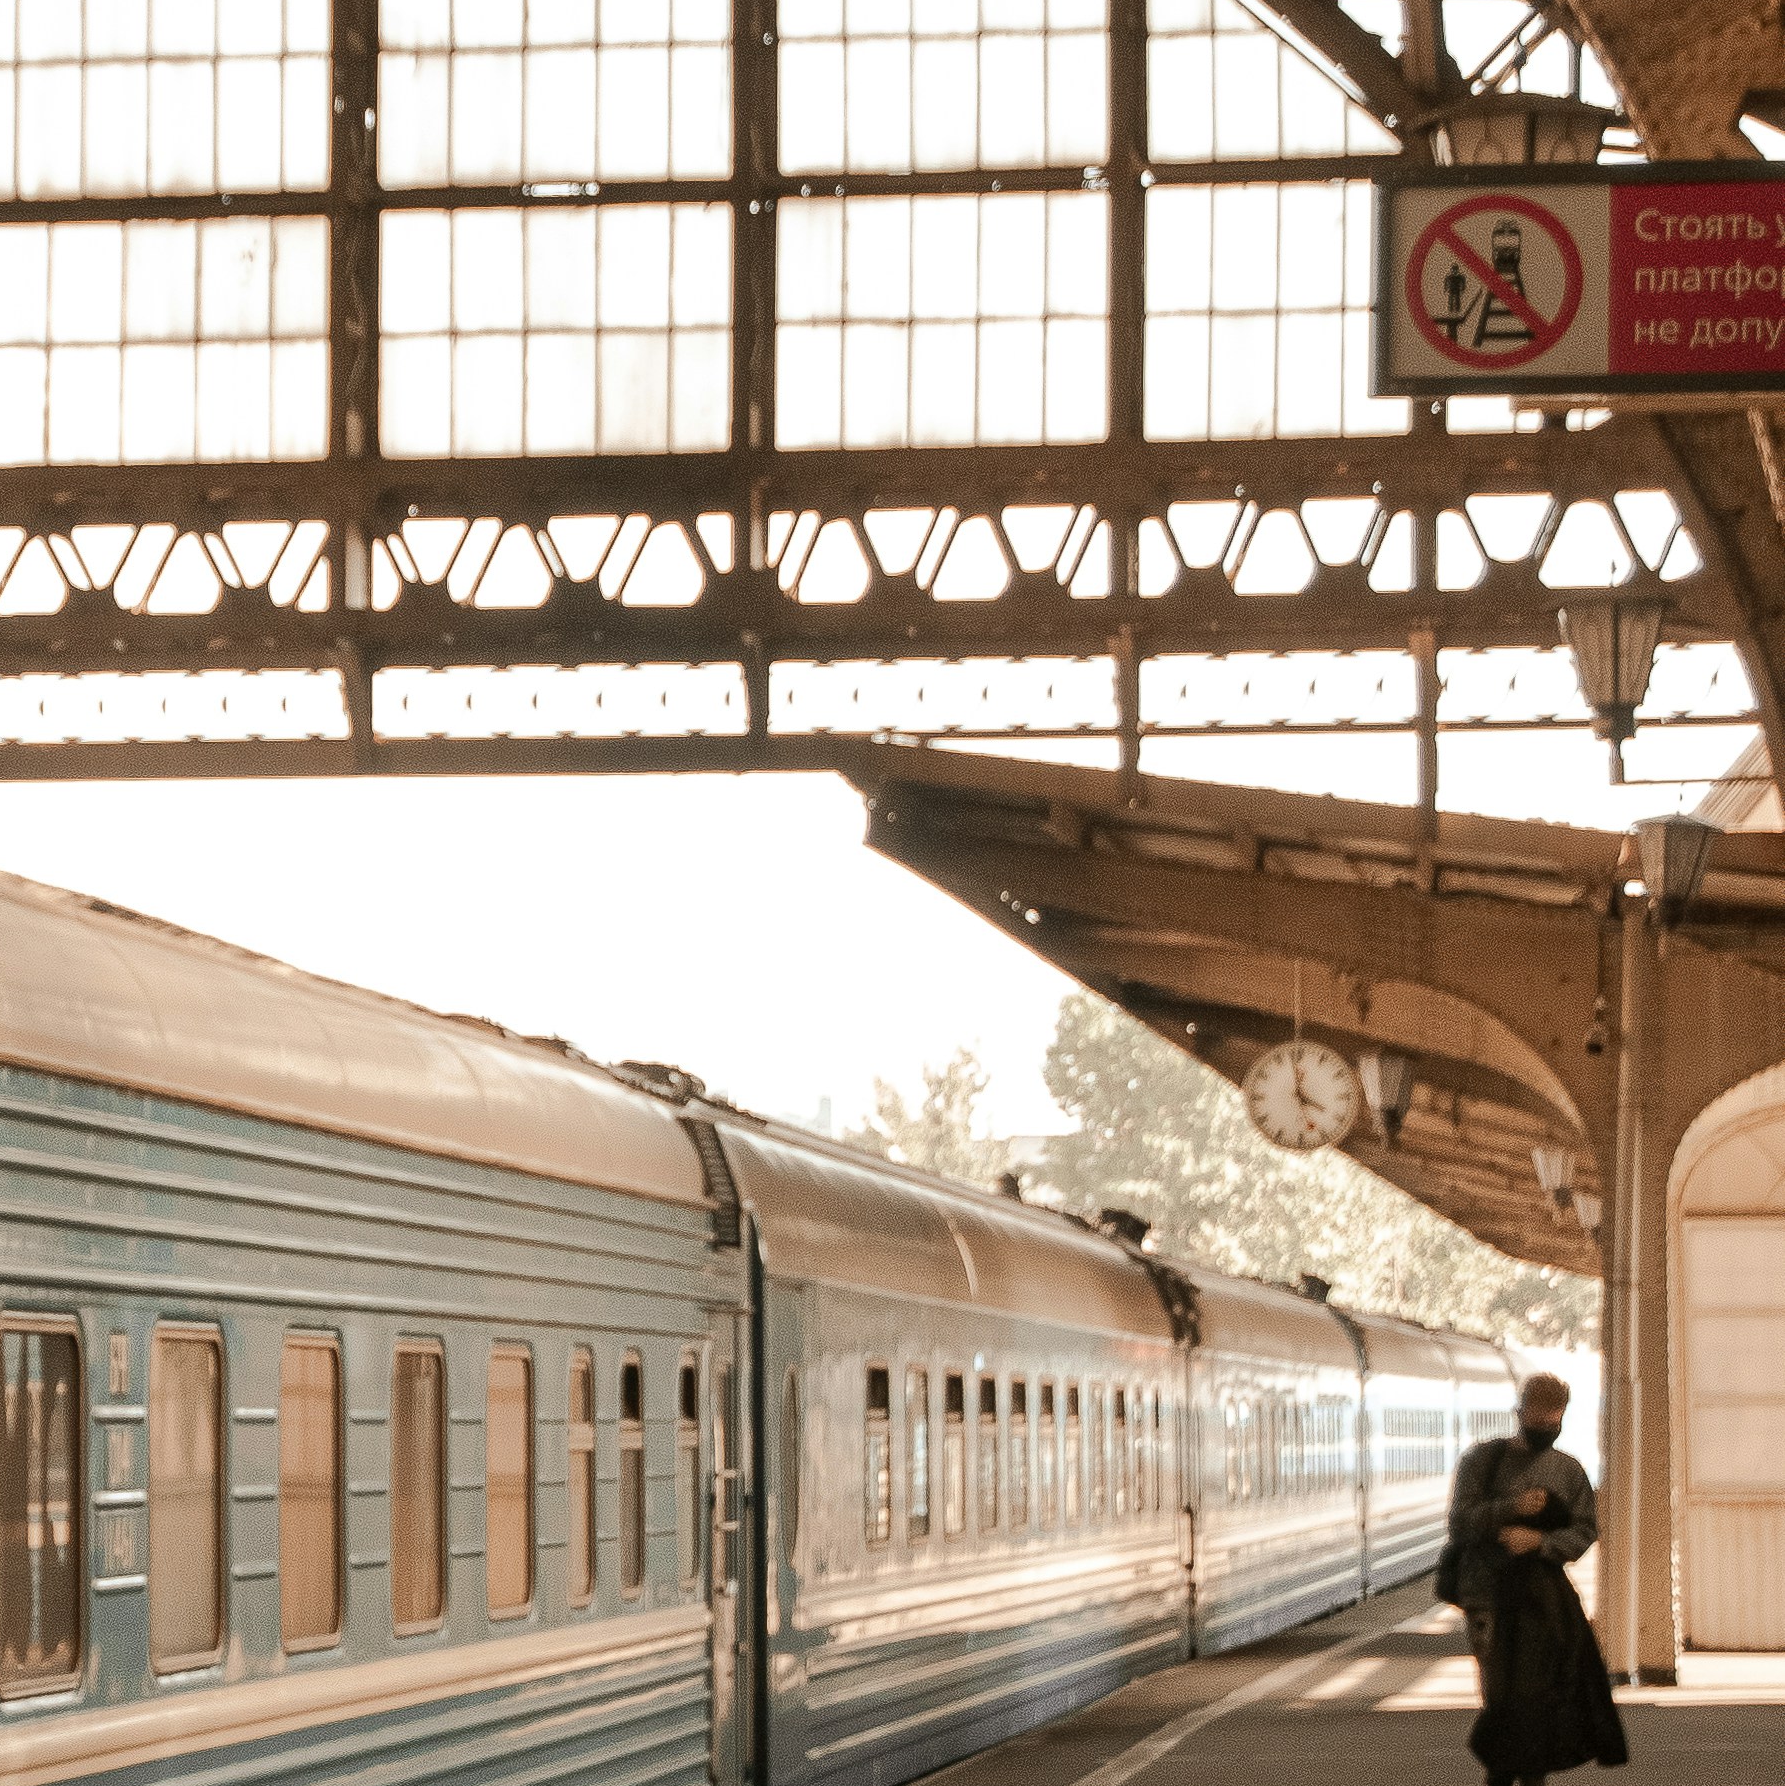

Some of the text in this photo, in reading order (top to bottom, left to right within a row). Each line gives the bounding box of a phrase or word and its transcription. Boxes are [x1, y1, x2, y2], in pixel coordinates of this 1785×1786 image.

[1635, 208, 1765, 241] Стоять
[1635, 259, 1785, 299] платфо
[1634, 318, 1785, 351] не допу
